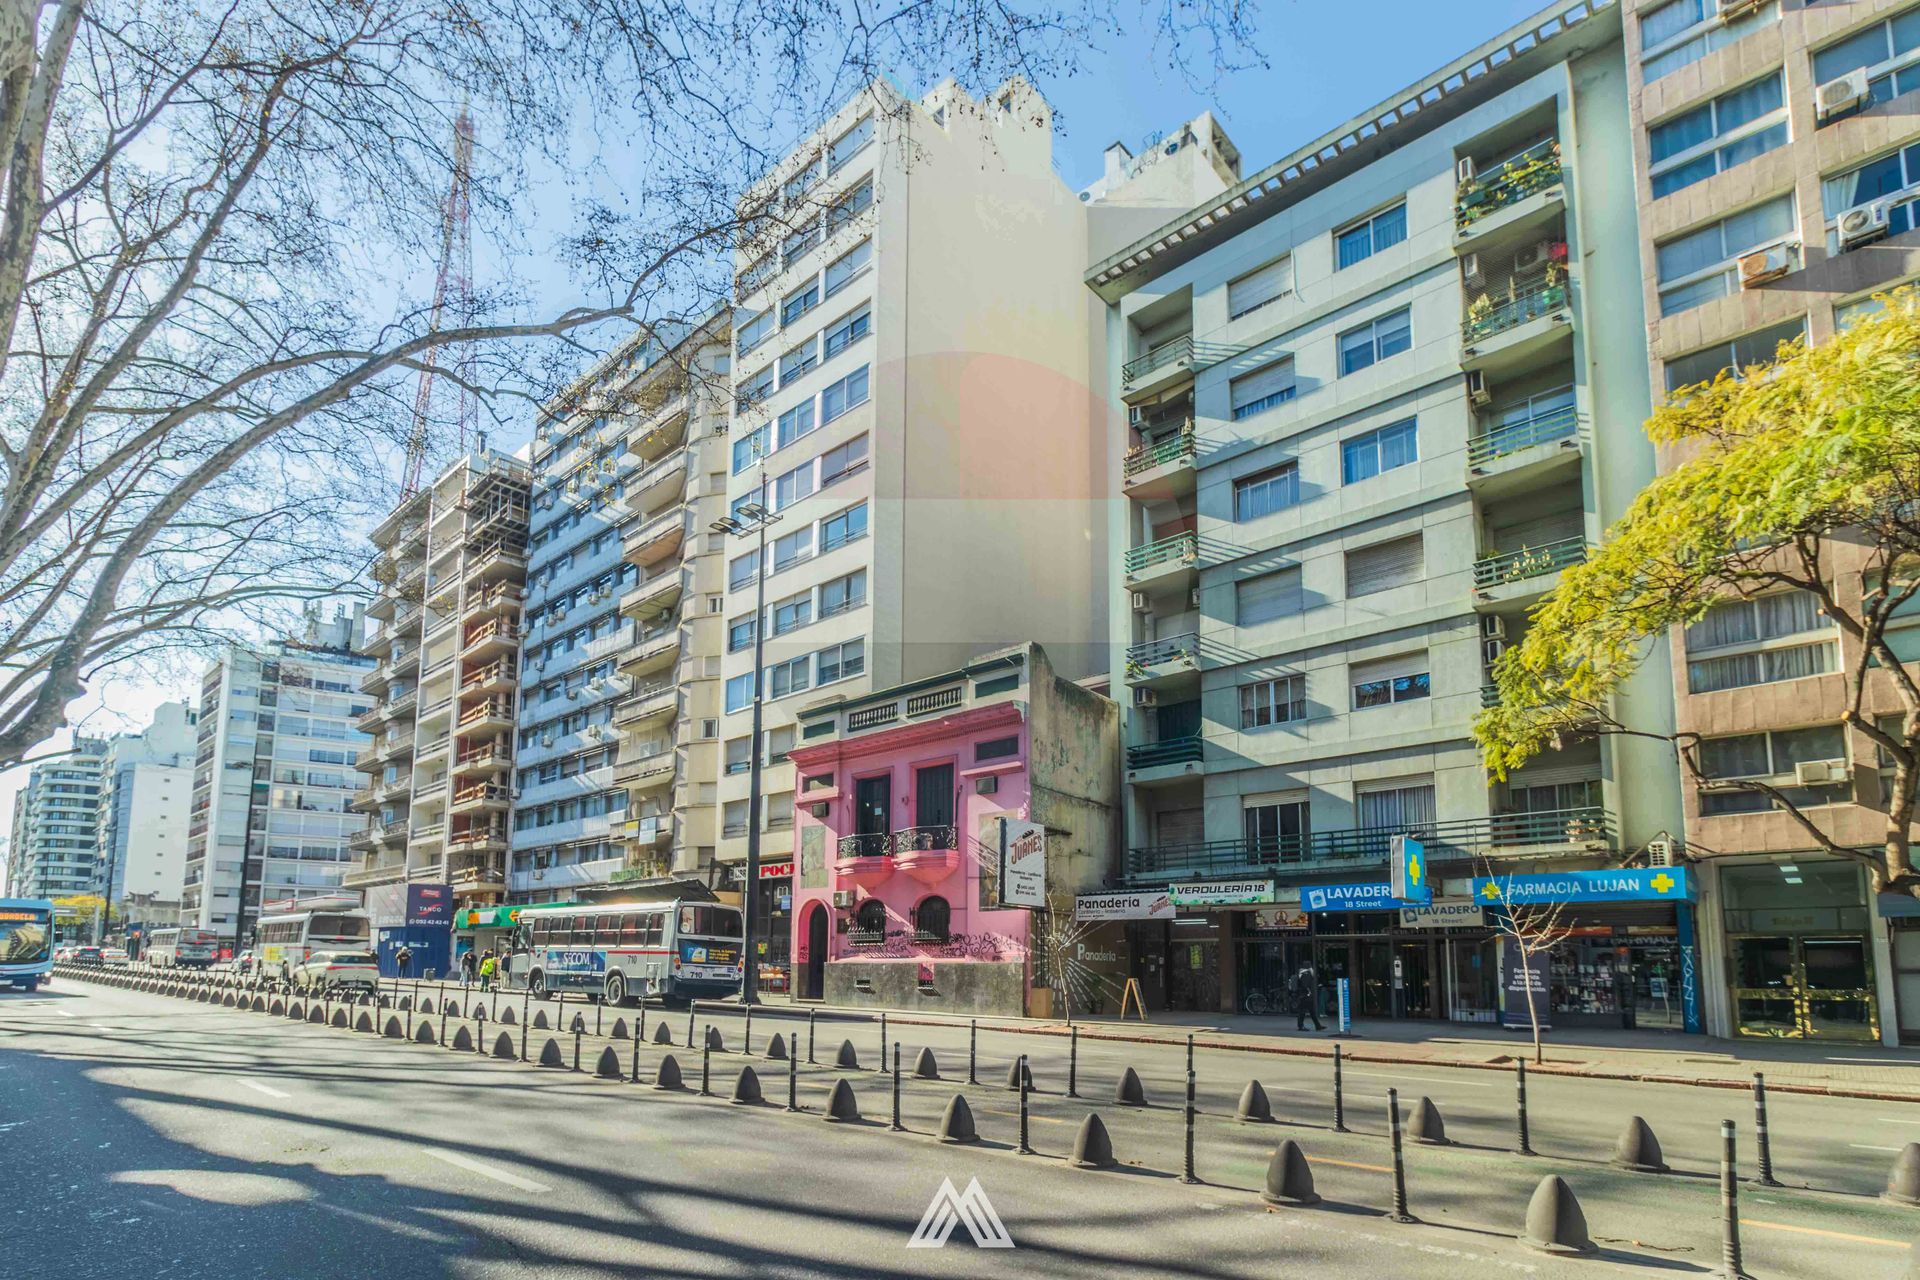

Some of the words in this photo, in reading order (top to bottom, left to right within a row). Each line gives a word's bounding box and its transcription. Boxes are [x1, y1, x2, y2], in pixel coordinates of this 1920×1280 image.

[1010, 832, 1043, 865] JUANES
[1252, 884, 1265, 892] 18
[1327, 885, 1392, 899] LAVADER
[1508, 881, 1582, 897] FARMACIA
[1589, 878, 1640, 894] LUJAN
[1078, 896, 1140, 909] Panadería
[1355, 900, 1382, 908] Street
[1418, 905, 1480, 916] LAVADERO
[563, 952, 590, 965] SECOM
[627, 955, 637, 964] 710
[690, 971, 703, 979] 710
